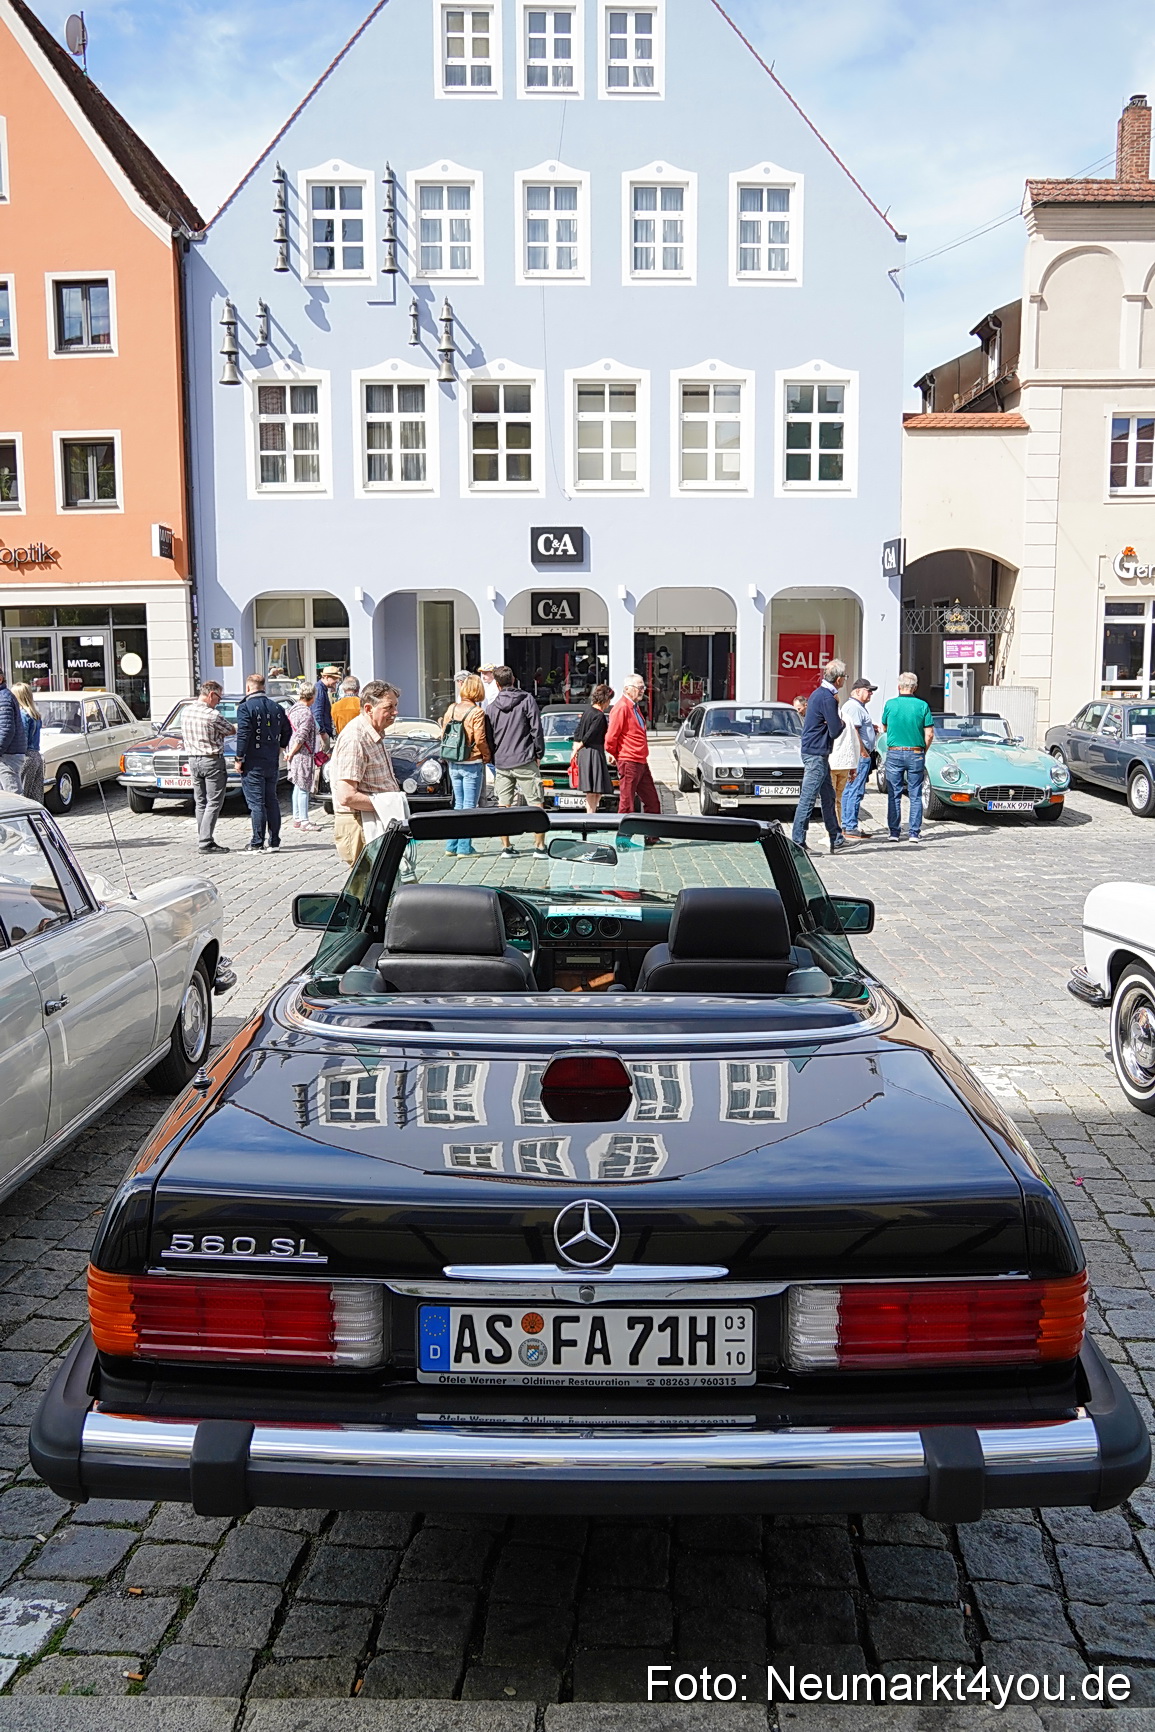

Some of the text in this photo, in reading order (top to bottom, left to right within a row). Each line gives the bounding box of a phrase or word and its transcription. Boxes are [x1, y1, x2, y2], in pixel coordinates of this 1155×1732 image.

[537, 533, 577, 556] C&A
[0, 542, 57, 568] optik
[537, 599, 574, 620] C&A
[880, 613, 886, 622] 7
[781, 650, 830, 669] SALE
[170, 1233, 319, 1257] 560 SL
[724, 1316, 746, 1330] 03
[453, 1314, 513, 1365] AS
[552, 1315, 612, 1365] FA
[627, 1316, 716, 1366] 71H
[429, 1345, 441, 1359] D
[725, 1351, 746, 1366] 10
[438, 1373, 467, 1384] Öfele
[470, 1376, 507, 1385] Werner
[522, 1376, 566, 1386] Oldtimer
[568, 1377, 631, 1387] Restauration
[659, 1378, 690, 1386] 08263
[700, 1377, 737, 1386] 960315
